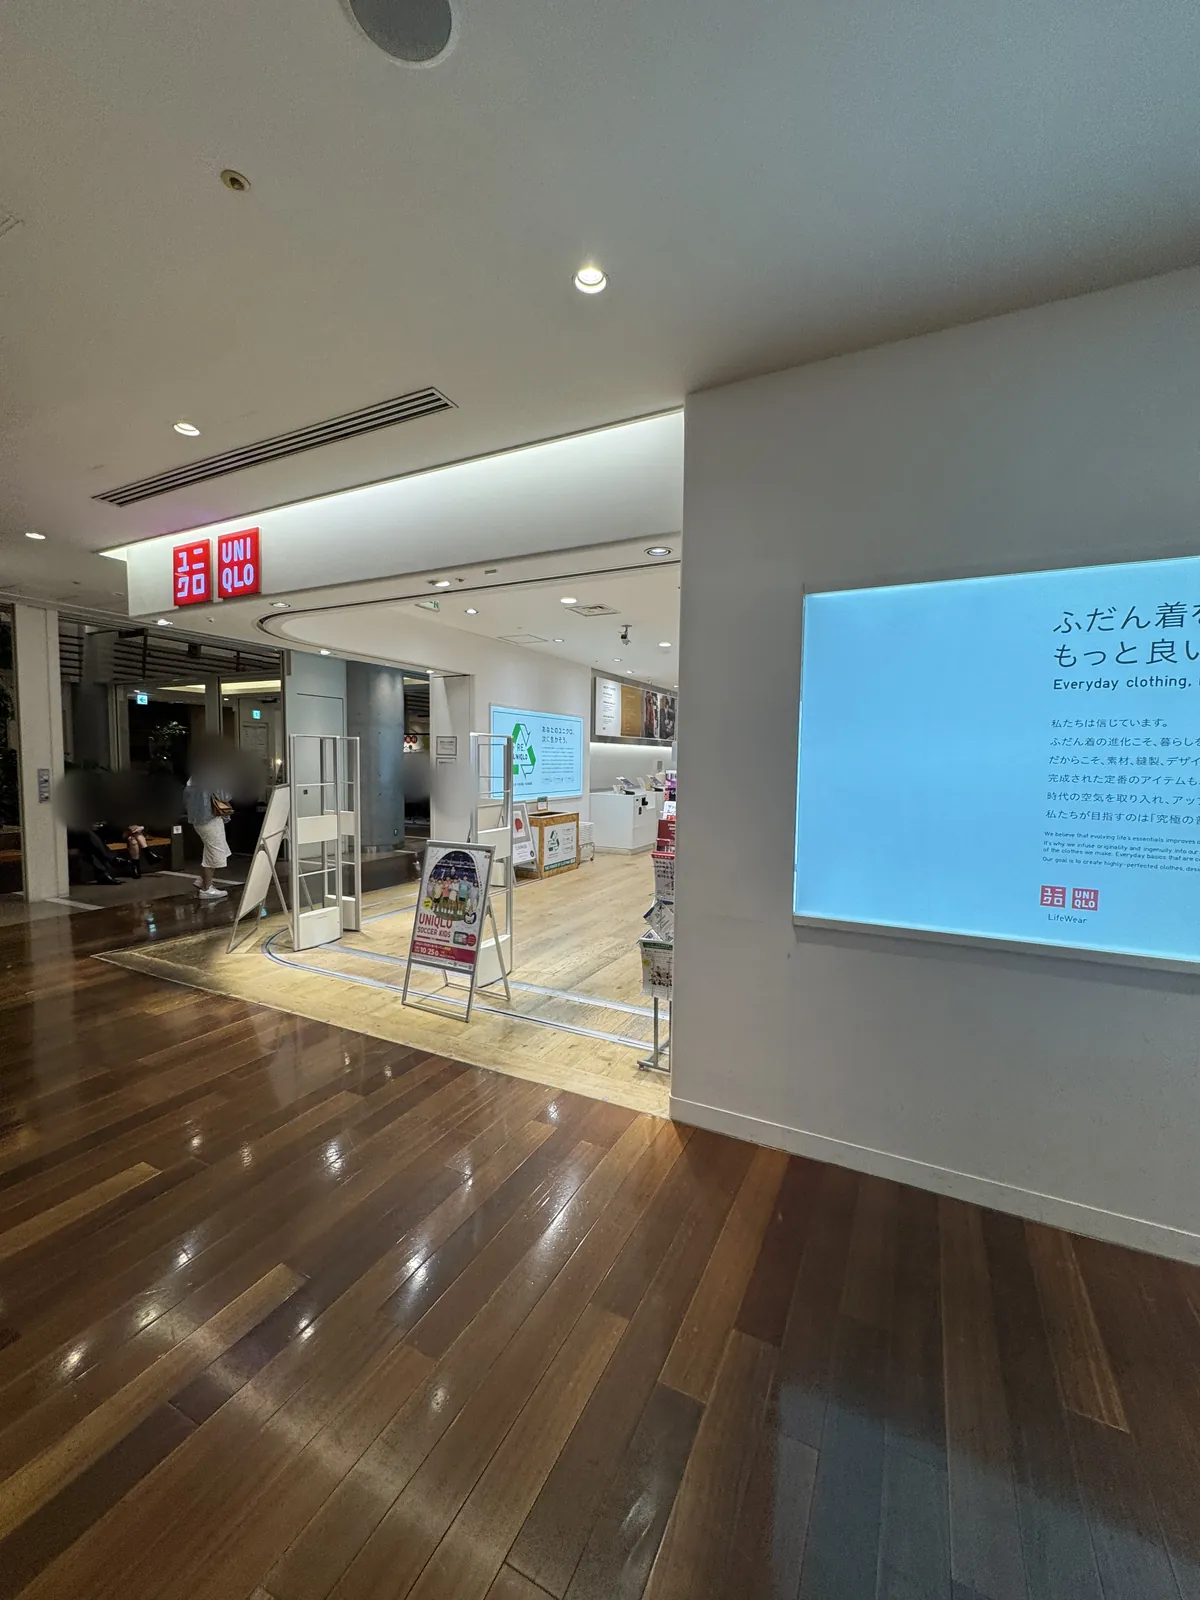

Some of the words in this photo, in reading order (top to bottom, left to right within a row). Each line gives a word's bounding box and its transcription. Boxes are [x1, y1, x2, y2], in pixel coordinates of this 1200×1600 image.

[222, 537, 251, 563] UNI
[178, 547, 205, 573] ユニ
[222, 563, 254, 592] QLO
[177, 573, 205, 597] クロ
[1053, 677, 1119, 692] Everyday
[1126, 675, 1192, 690] clothing,
[1051, 718, 1168, 728] 私たちは信じています。
[1048, 774, 1200, 786] 完成された定番のアイテムも
[1075, 890, 1095, 899] UNI
[1074, 899, 1096, 908] QLO
[419, 912, 453, 929] UNIQLO
[1048, 913, 1088, 923] LifeWear
[417, 926, 438, 936] SOCCER
[438, 930, 451, 938] KIDS
